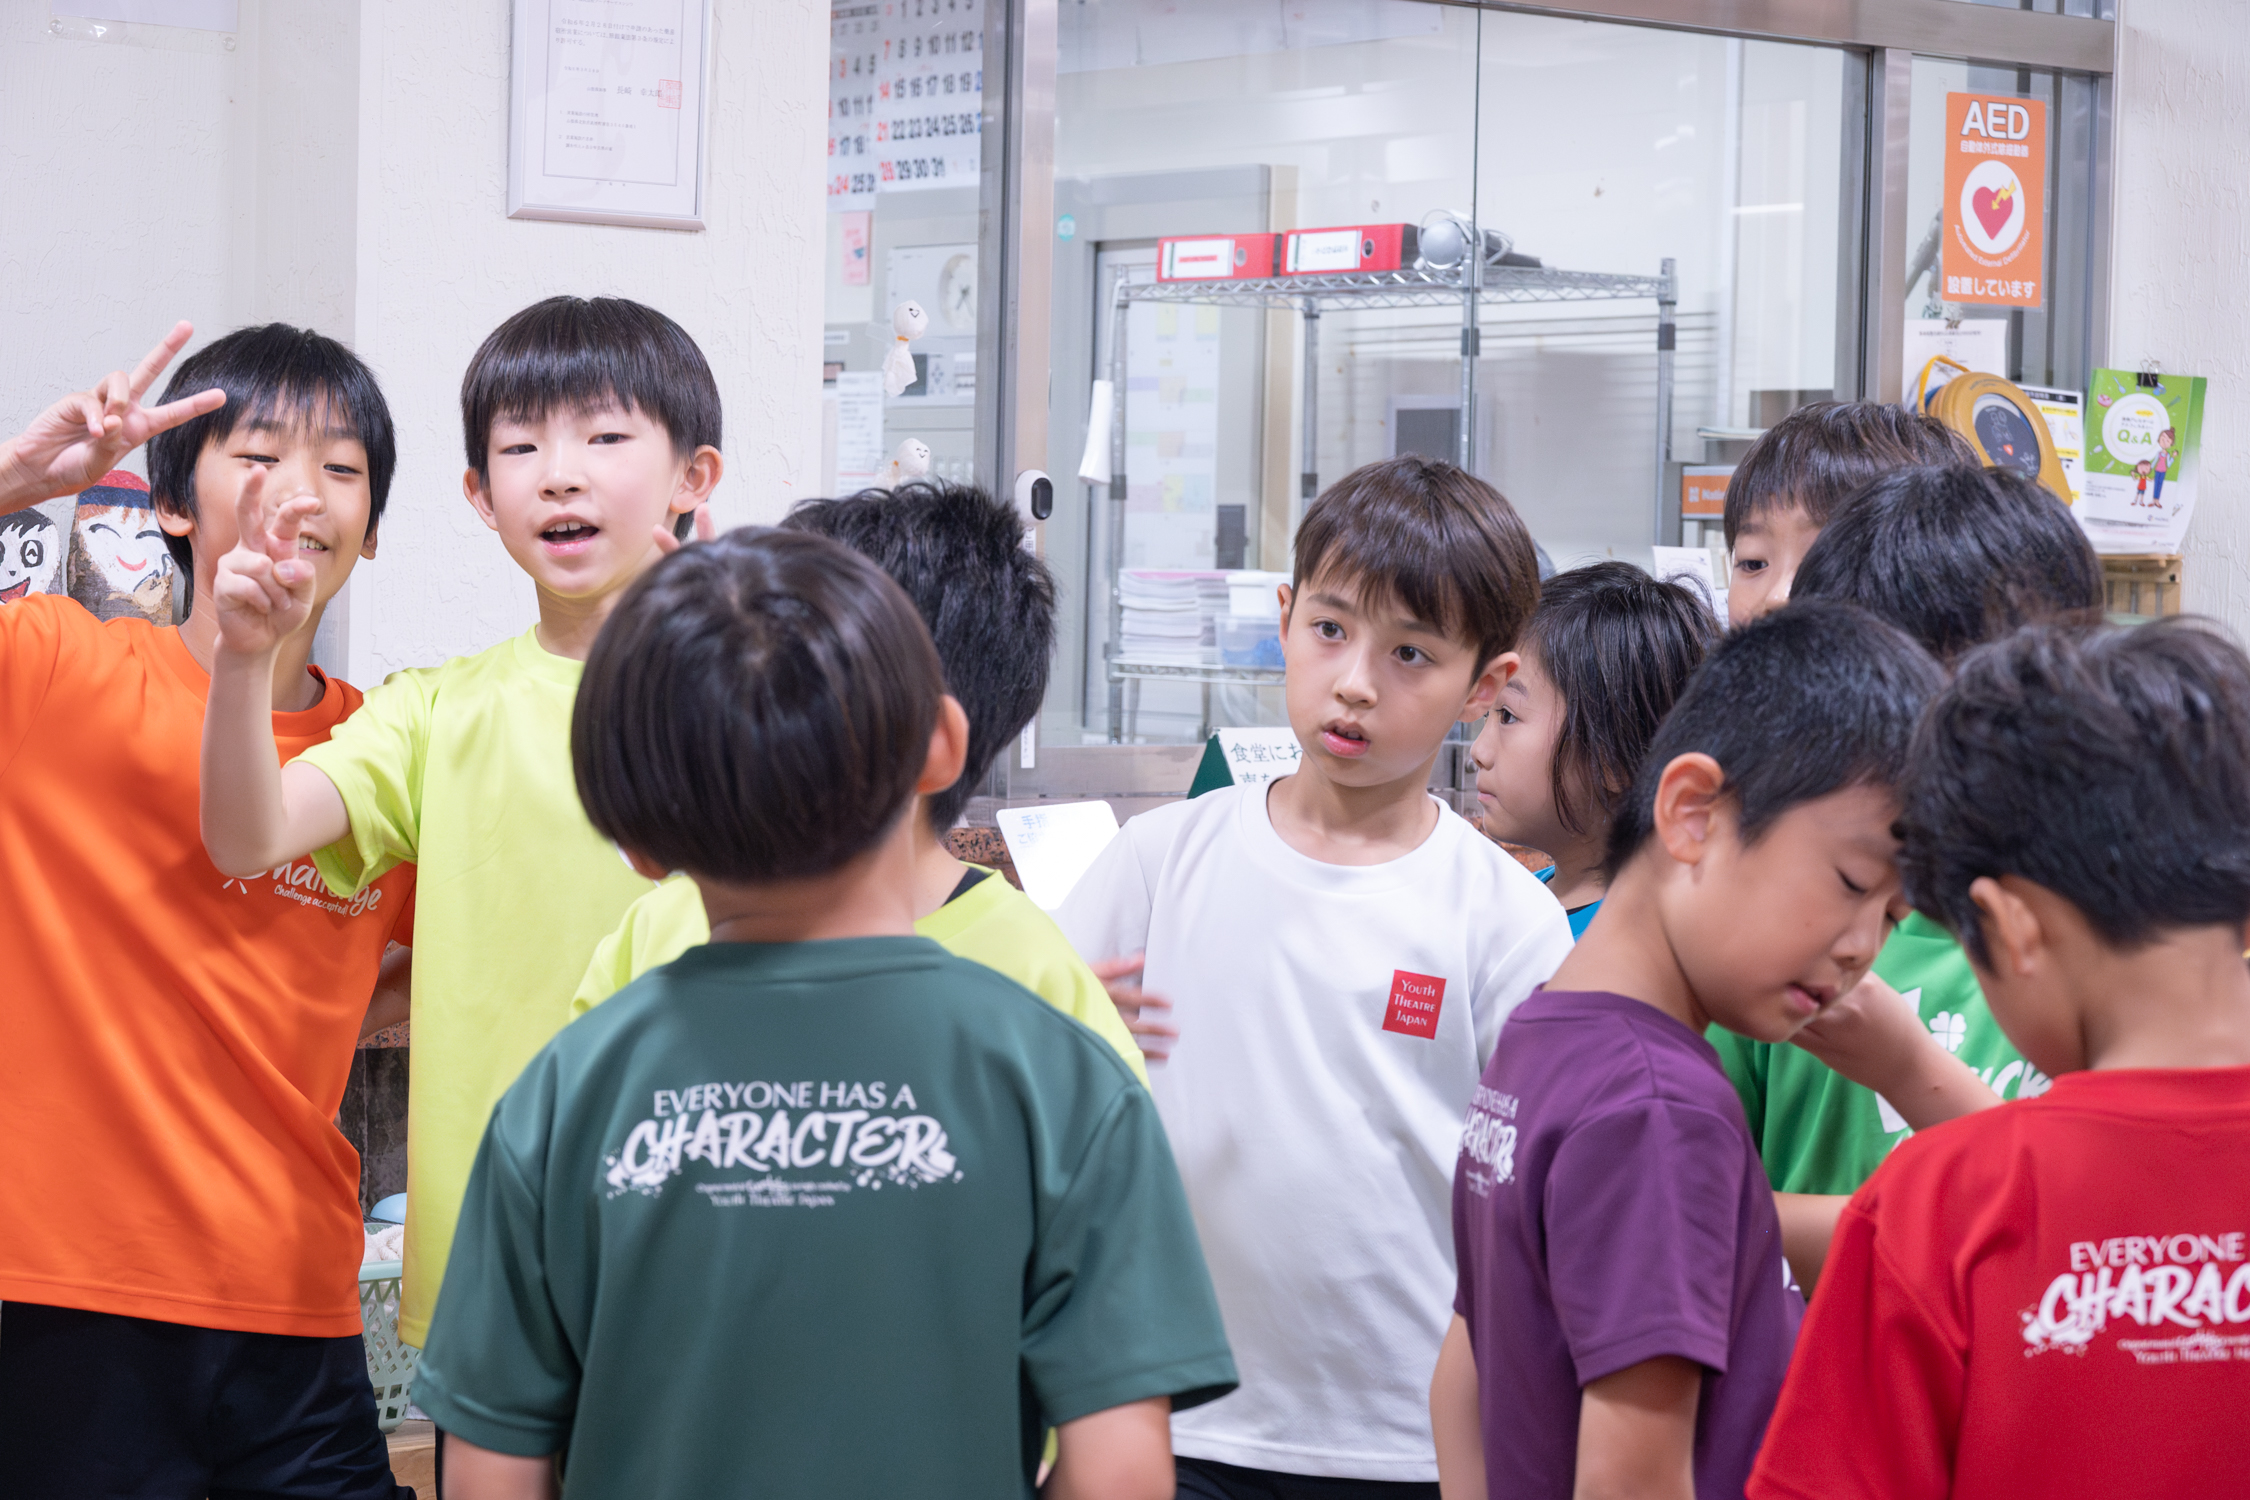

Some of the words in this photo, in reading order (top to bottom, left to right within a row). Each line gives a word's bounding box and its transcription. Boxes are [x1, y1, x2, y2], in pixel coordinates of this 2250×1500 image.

[1960, 99, 2030, 141] AED
[1947, 275, 2036, 299] 設置しています
[274, 884, 312, 907] Challenge
[311, 897, 350, 918] accepted!
[653, 1081, 813, 1117] EVERYONE
[819, 1081, 887, 1109] HAS
[891, 1083, 918, 1111] A
[620, 1108, 956, 1179] CHARACTER
[2069, 1231, 2246, 1272] EVERYONE
